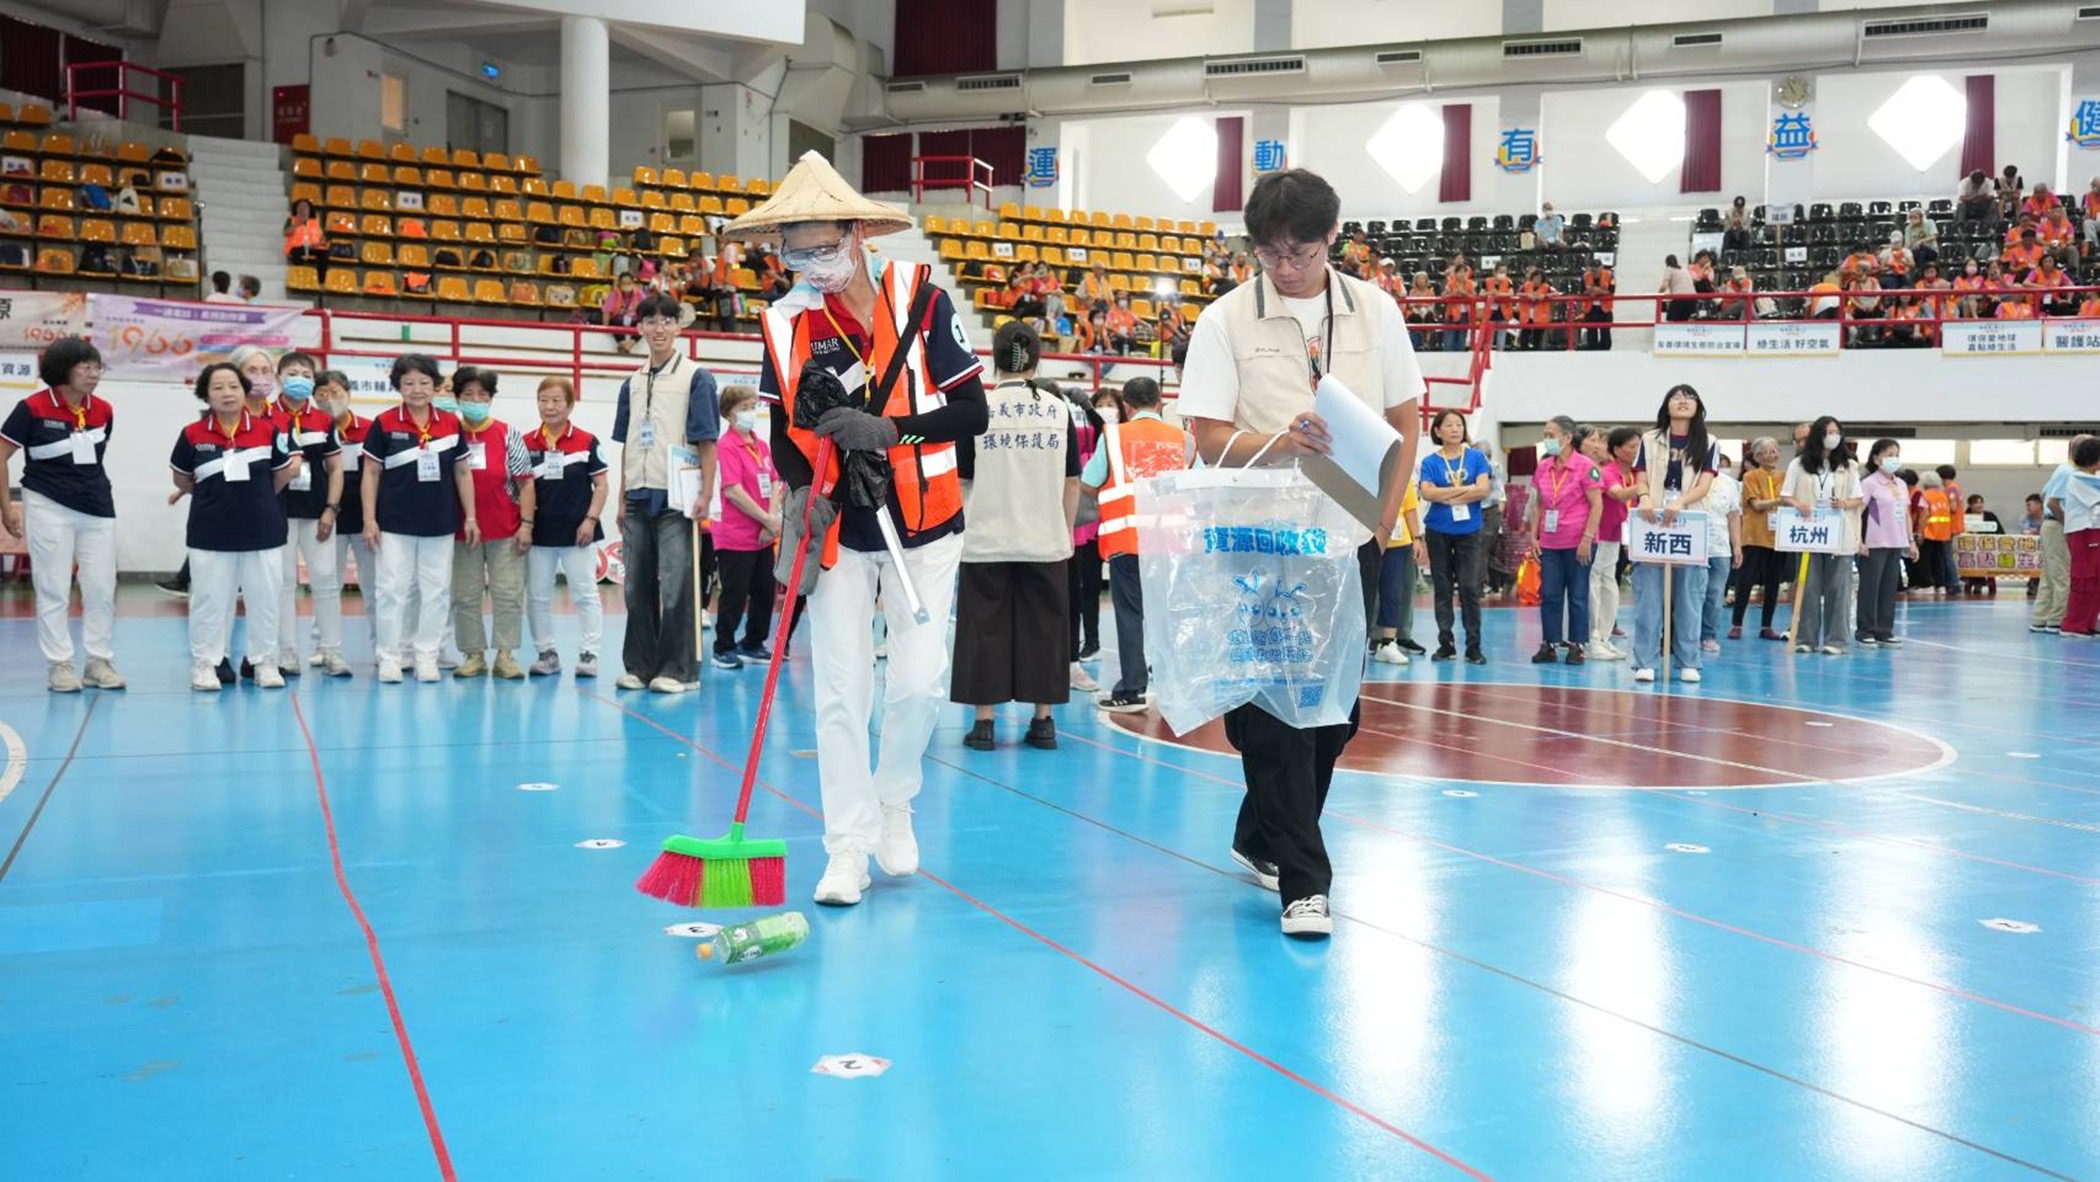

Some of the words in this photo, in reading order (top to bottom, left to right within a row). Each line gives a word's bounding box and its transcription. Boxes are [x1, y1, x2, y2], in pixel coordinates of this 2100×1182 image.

[1028, 147, 1057, 179] 運
[1255, 140, 1286, 172] 動
[1502, 128, 1535, 162] 有
[1774, 112, 1811, 149] 益
[107, 324, 194, 356] 1966
[2055, 334, 2100, 349] 醫護站
[983, 431, 1060, 450] 環境保護局
[1203, 526, 1327, 557] 資源回收袋
[1644, 531, 1693, 556] 新西
[1789, 524, 1829, 545] 杭州
[1958, 536, 2040, 552] 環保愛地
[839, 1059, 863, 1071] 2
